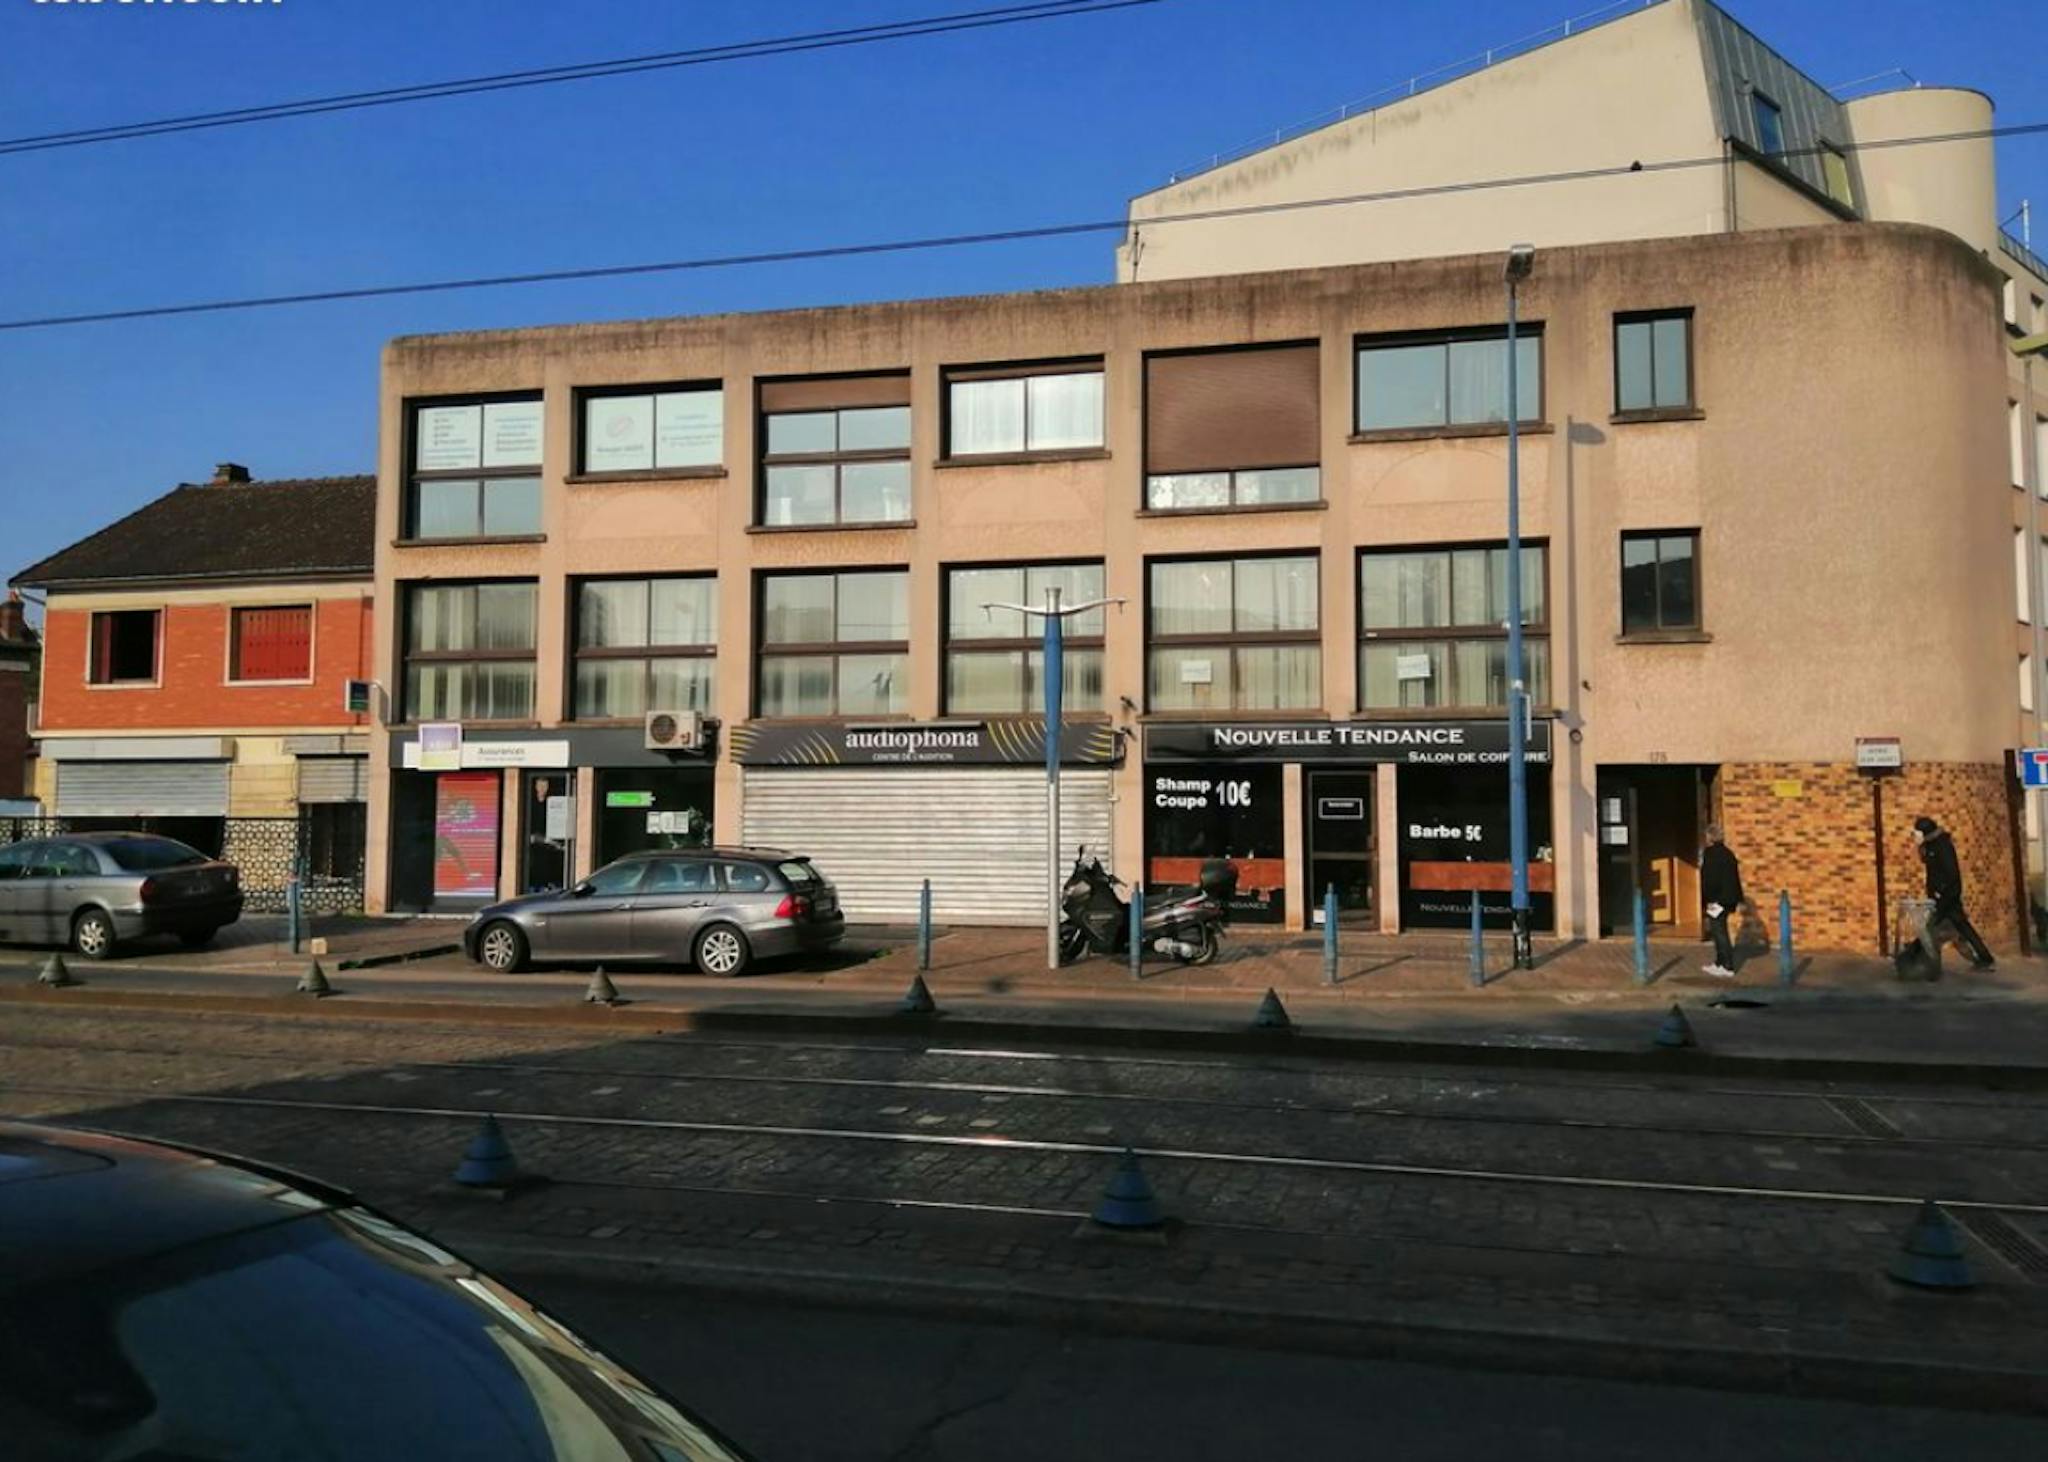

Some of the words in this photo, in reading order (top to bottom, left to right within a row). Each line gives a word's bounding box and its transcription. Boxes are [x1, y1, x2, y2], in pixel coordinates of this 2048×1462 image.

[845, 729, 979, 753] audiophona
[1214, 728, 1332, 745] NOUVELLE
[1334, 727, 1464, 745] TENDANCE
[1408, 751, 1455, 763] SALON
[1457, 751, 1476, 763] DE
[1156, 777, 1211, 794] Shamp
[1216, 781, 1251, 807] 10€
[1156, 794, 1208, 810] Coupe
[1409, 824, 1461, 839] Barbe
[1465, 824, 1482, 841] 5€
